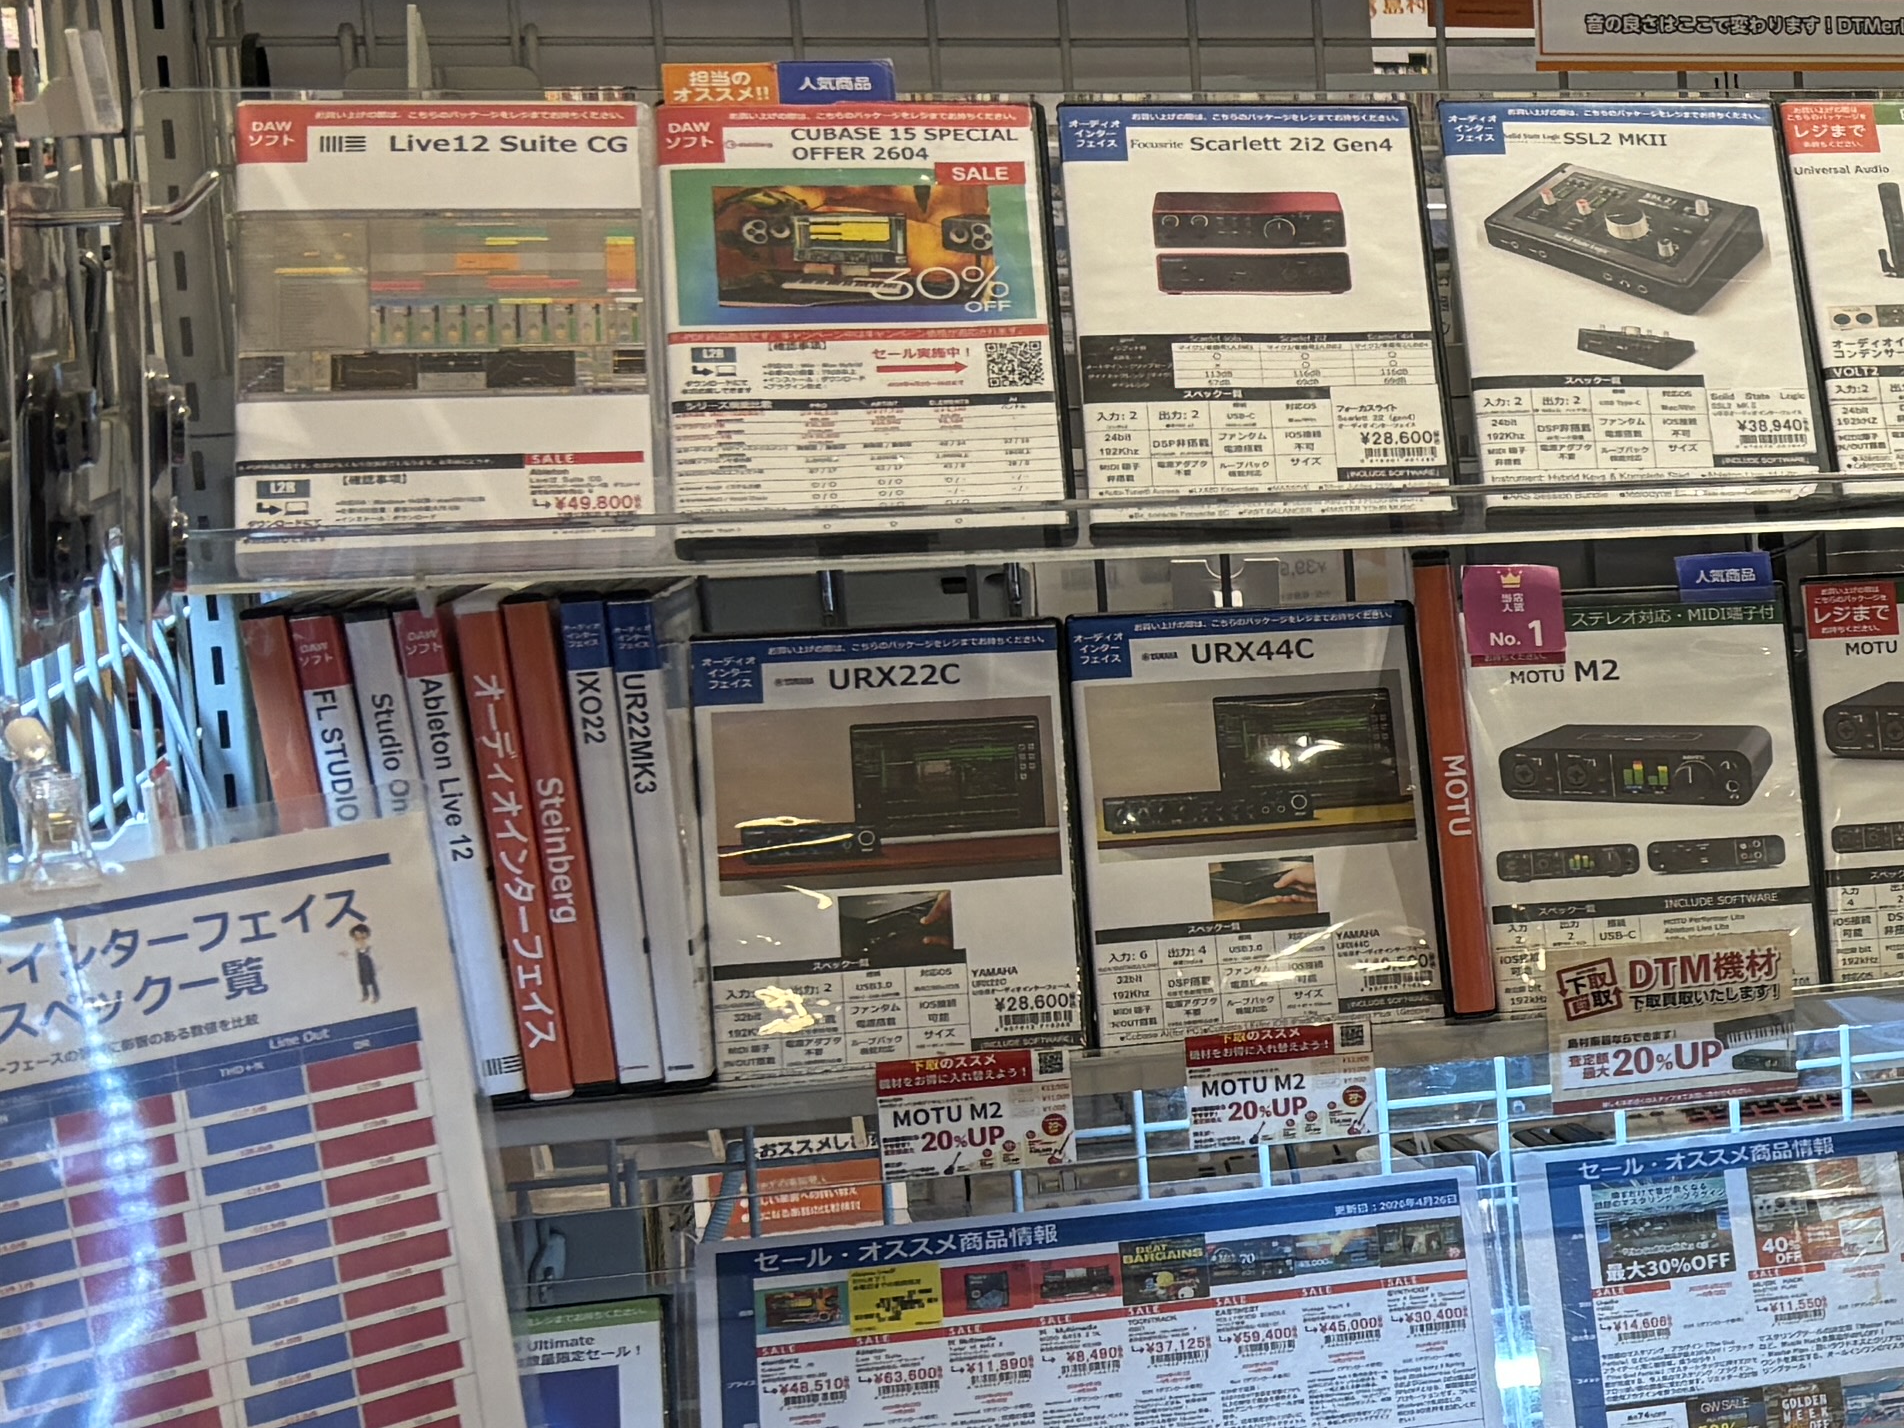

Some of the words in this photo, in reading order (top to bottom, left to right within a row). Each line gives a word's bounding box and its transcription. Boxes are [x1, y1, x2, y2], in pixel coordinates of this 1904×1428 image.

[799, 74, 873, 93] 人気商品
[388, 132, 490, 155] Live12
[498, 133, 583, 155] Suite
[591, 135, 629, 154] CG
[1130, 139, 1184, 152] Focusrite
[1189, 133, 1283, 154] Scarlett
[1289, 133, 1327, 152] 2i2
[1332, 134, 1394, 153] Gen4
[1563, 131, 1611, 147] SSL2
[1617, 132, 1668, 148] MKII
[790, 146, 866, 162] OFFER
[873, 146, 930, 162] 2604
[1695, 567, 1757, 584] 人気商品
[1812, 603, 1891, 622] レジまで
[1191, 638, 1316, 664] URX44C
[1844, 641, 1898, 657] MOTU
[829, 663, 961, 690] URX22C
[1509, 667, 1566, 685] MOTU
[1573, 659, 1621, 683] M2
[619, 672, 658, 795] UR22MK3
[1441, 754, 1474, 838] MOTU
[474, 673, 557, 1050] オーディオインターフェイス
[535, 776, 577, 925] Steinberg
[1628, 951, 1783, 988] DTM機材
[1200, 1078, 1268, 1097] MOTU
[1273, 1073, 1307, 1091] M2
[892, 1107, 962, 1129] MOTU
[968, 1102, 1004, 1123] M2
[1576, 1135, 1835, 1178] セール・オススメ商品情報
[753, 1224, 1059, 1272] セール・オススメ商品情報
